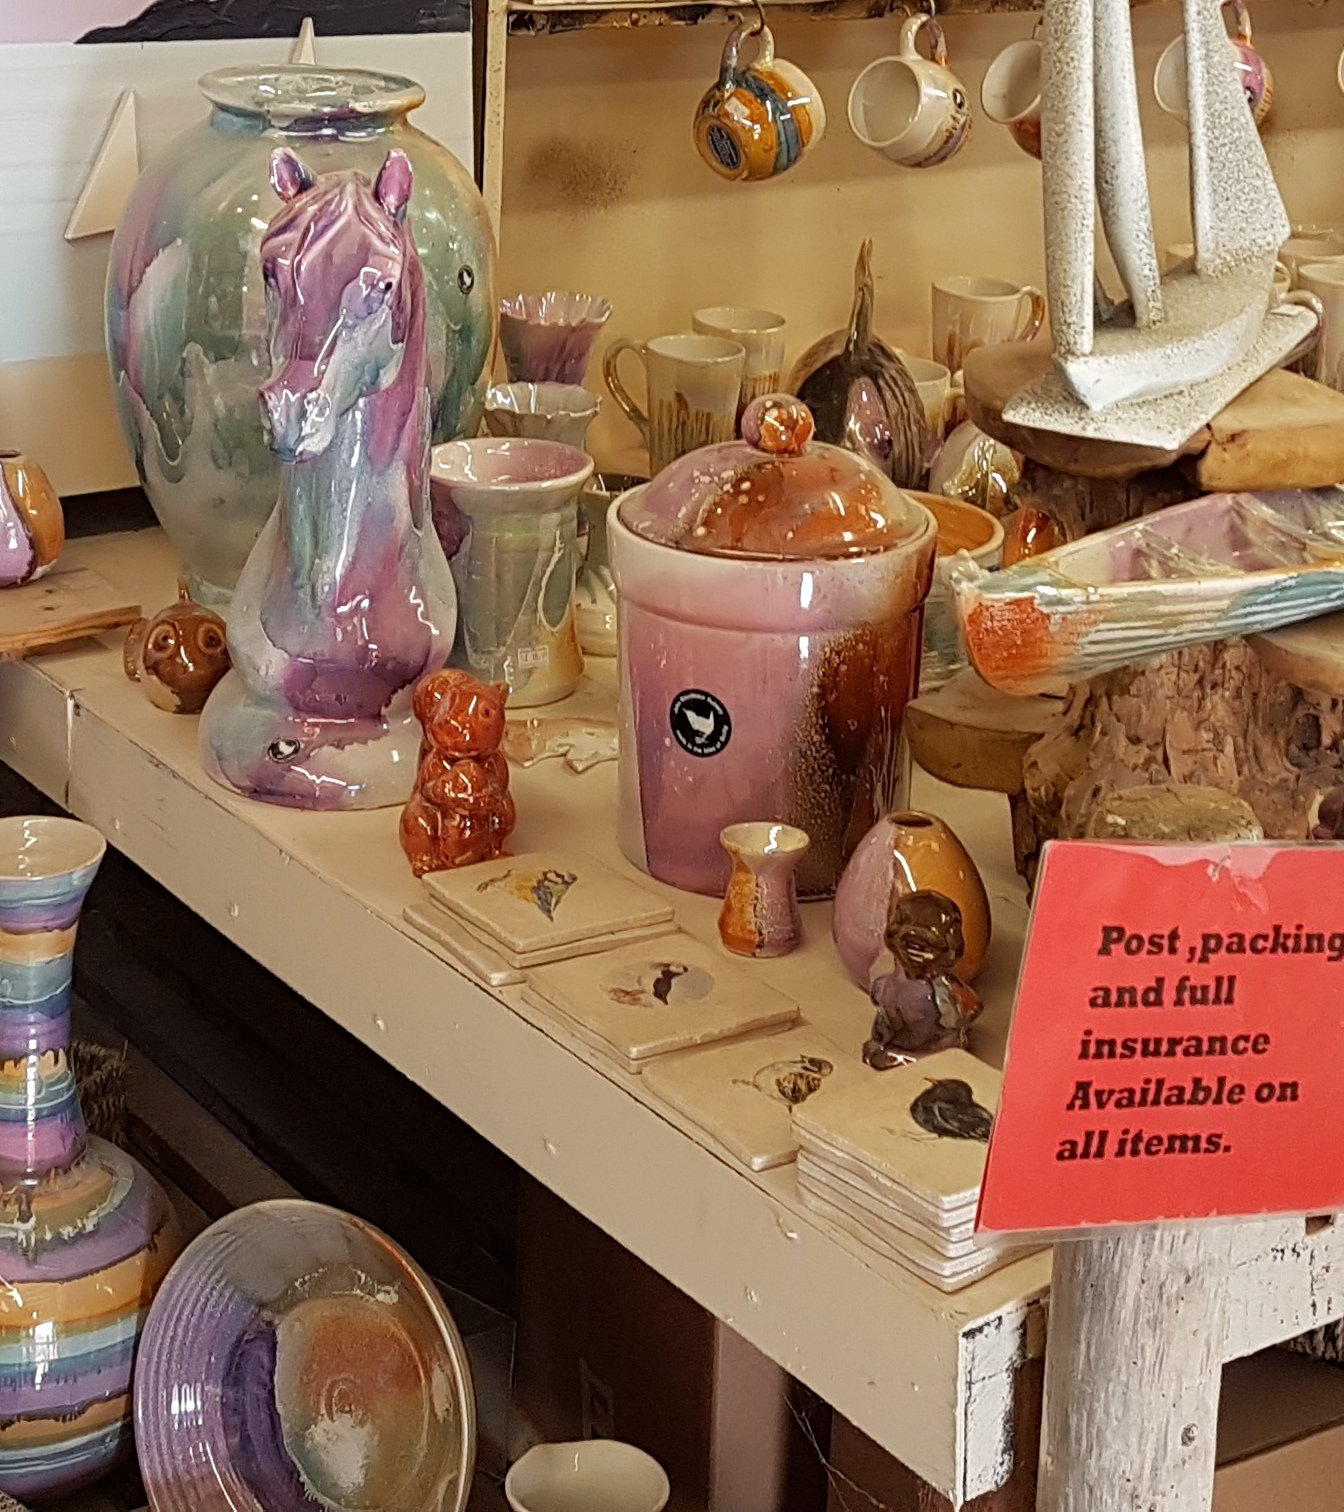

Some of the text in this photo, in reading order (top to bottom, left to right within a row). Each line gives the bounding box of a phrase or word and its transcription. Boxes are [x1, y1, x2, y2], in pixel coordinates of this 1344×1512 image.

[1097, 925, 1182, 957] Post
[1088, 975, 1237, 1009] and full
[1078, 1030, 1271, 1060] insurance
[1065, 1076, 1300, 1112] Available on
[1056, 1128, 1233, 1162] all items.
